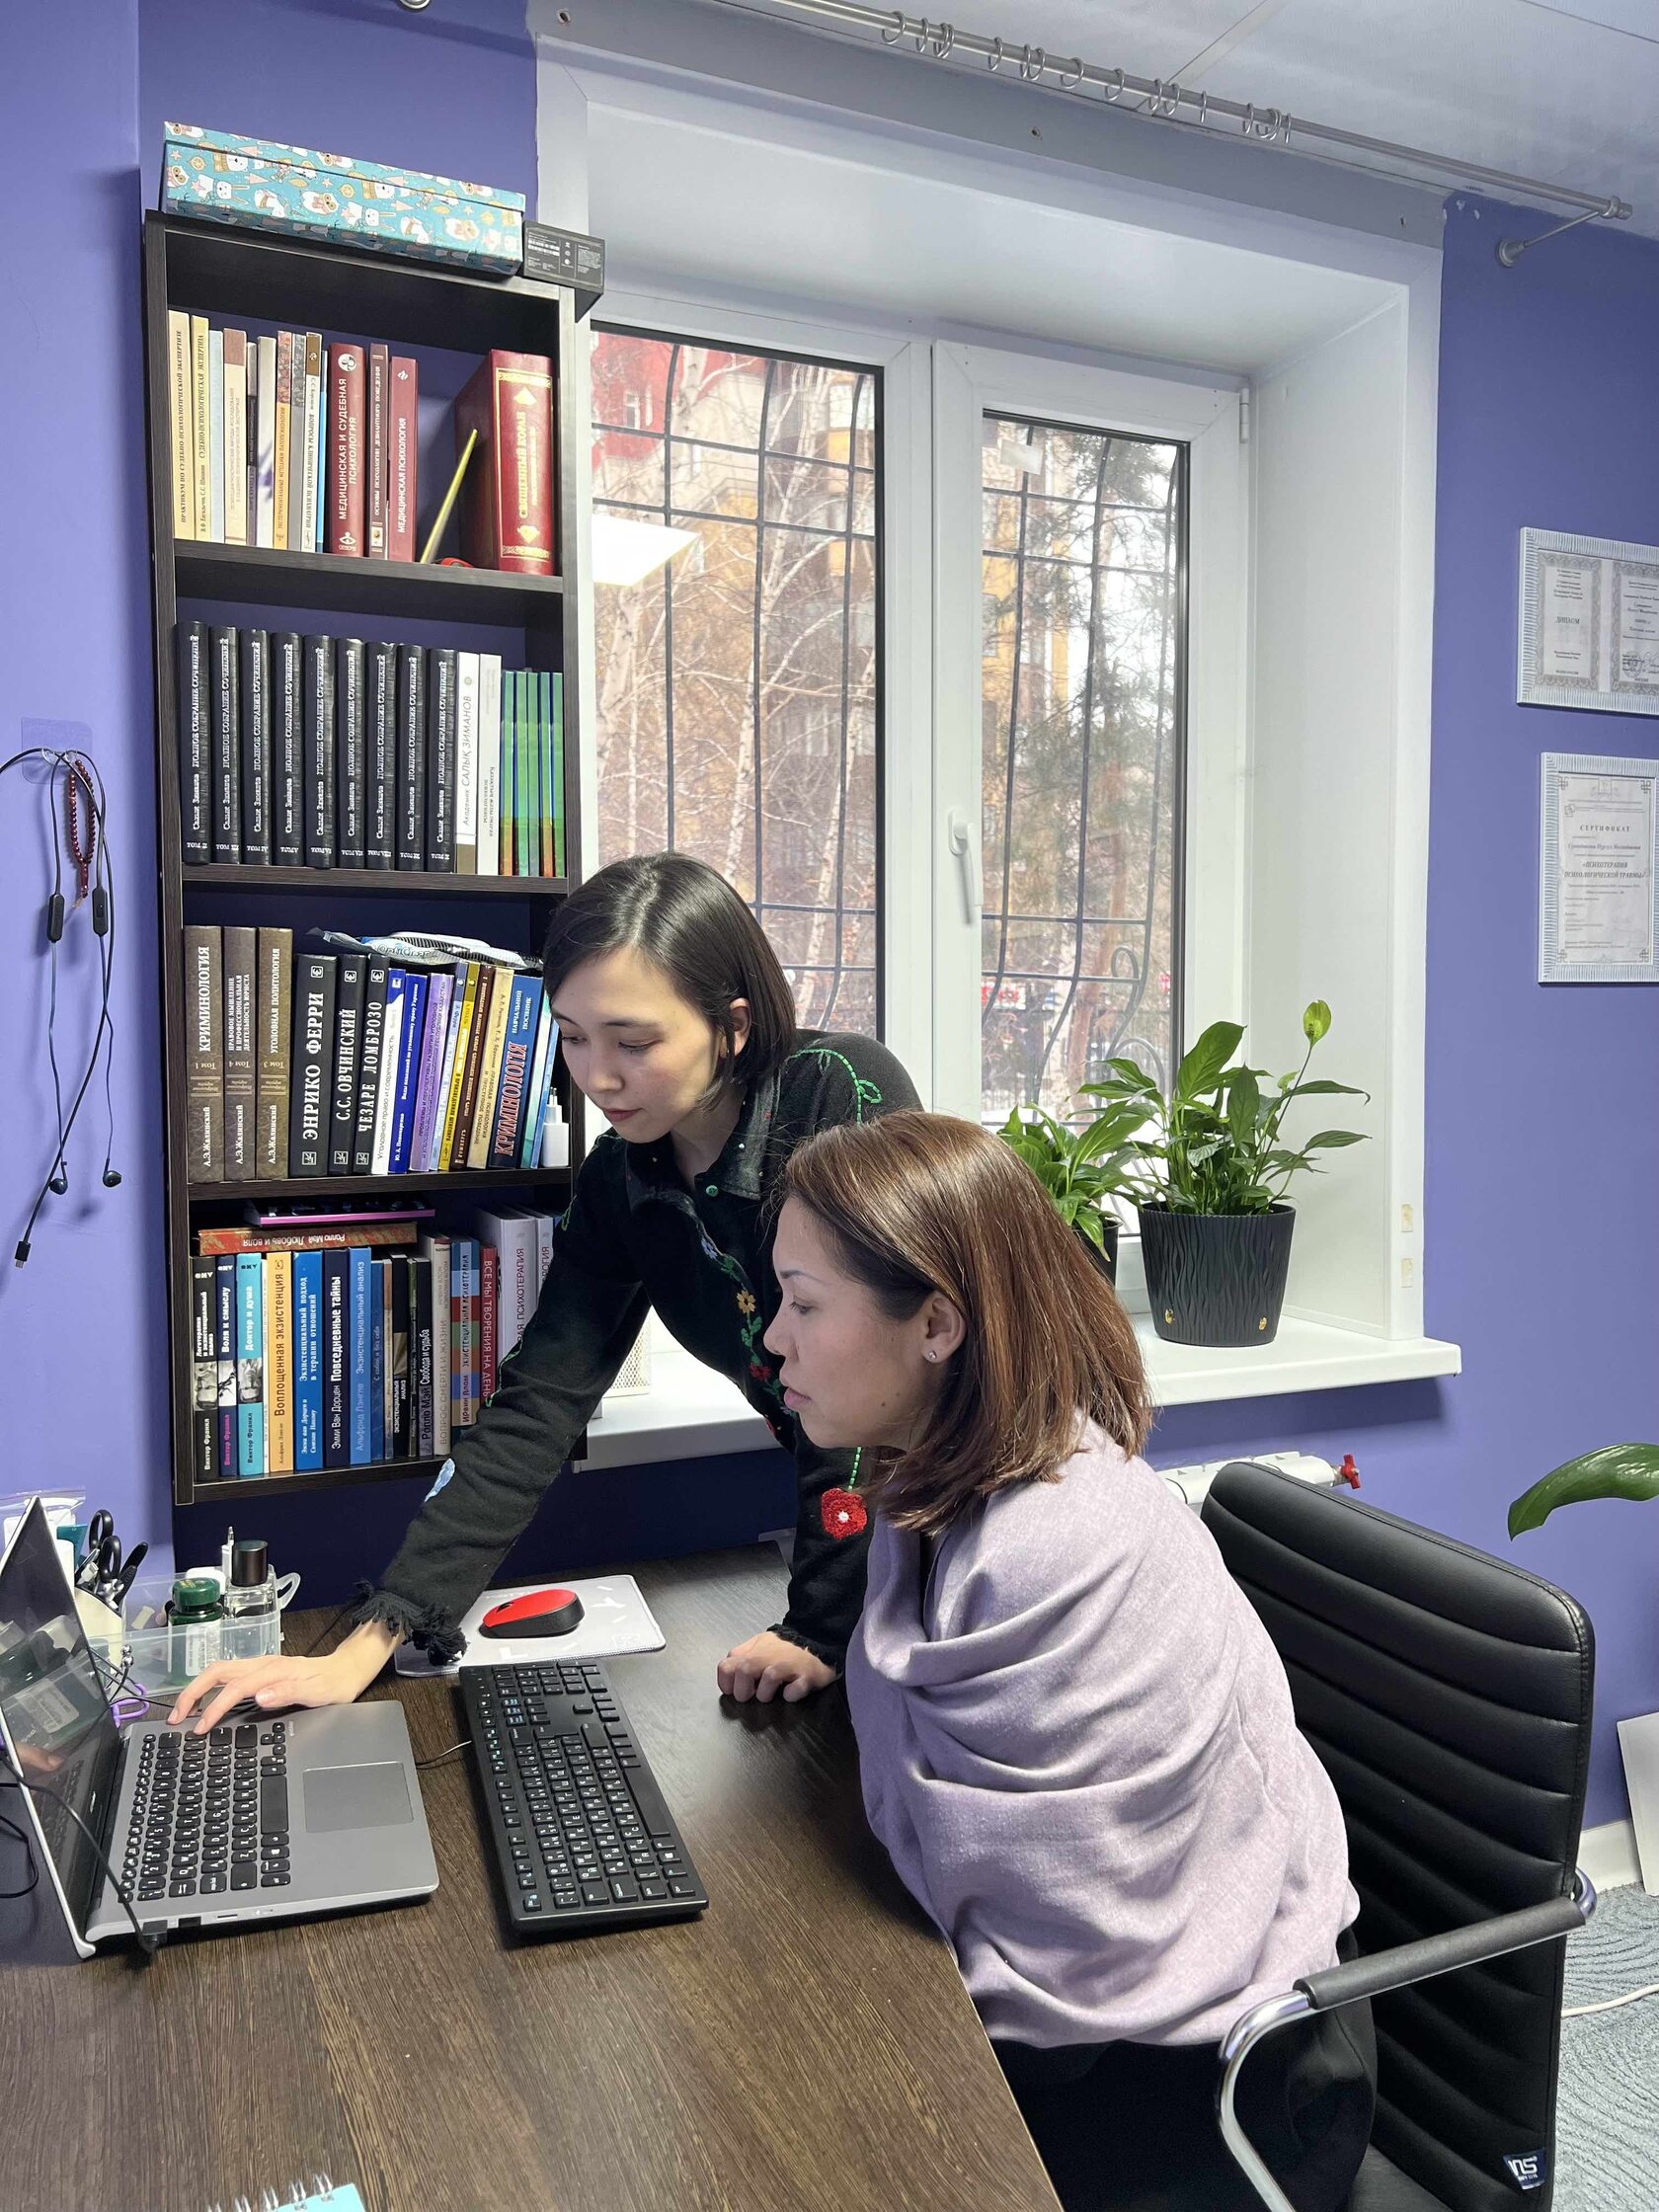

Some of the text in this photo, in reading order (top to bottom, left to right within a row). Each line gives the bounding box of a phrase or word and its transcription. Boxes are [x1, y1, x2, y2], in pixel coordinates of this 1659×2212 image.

[339, 379, 348, 431] СУДЕБНАЯ
[179, 472, 186, 482] ПО
[349, 417, 357, 484] ПСИХОЛОГИЯ
[397, 418, 407, 533] МЕДИЦИНСКАЯ ПСИХОЛОГИЯ
[339, 445, 348, 519] МЕДИЦИНСКАЯ
[462, 695, 472, 749] ЗИМАНОВ
[198, 946, 211, 1052] КРИМИНОЛОГИЯ
[272, 949, 280, 1005] ПОЛИТОЛОГИЯ
[512, 990, 522, 1034] НАВЧАЛЬНИЙ
[302, 992, 324, 1140] ЭНРИКО ФЕРРИ
[336, 1009, 356, 1121] С.С. ОВЧИНСКИЙ
[358, 1001, 383, 1132] ЧЕЗАРЕ ЛОМБРОЗО
[384, 1036, 395, 1091] современность
[381, 1098, 390, 1120] право
[494, 1041, 527, 1156] КРИМІНОЛОГІЯ
[377, 1120, 388, 1159] Уголовное
[272, 1236, 305, 1246] Любовь
[308, 1234, 323, 1243] Мэй
[324, 1234, 346, 1243] Ролло
[222, 1287, 231, 1321] смыслу
[246, 1286, 255, 1309] душа
[276, 1274, 286, 1340] экзистенция
[516, 1248, 525, 1320] ПСИХОТЕРАПИЯ
[246, 1320, 255, 1351] Доктор
[299, 1277, 309, 1382] Экзистенциальный подход
[308, 1294, 317, 1337] отношений
[461, 1255, 470, 1368] ЭКЗИСТЕНЦИАЛЬНАЯ ПСИХОТЕРАПИЯ
[482, 1260, 493, 1397] ВСЕ МЫ ТВОРЕНИЯ НА ДЕНЬ
[310, 1341, 319, 1373] терапии
[330, 1277, 343, 1450] Эмми Ван Дорцен Повседневные тайны
[356, 1262, 365, 1452] Альфрид Лэнгле Экзистенциальный анализ
[420, 1329, 432, 1351] судьба
[275, 1344, 286, 1416] Воплощенная
[420, 1358, 431, 1384] Свобода
[421, 1387, 432, 1408] Мэй
[422, 1410, 432, 1440] Ролло
